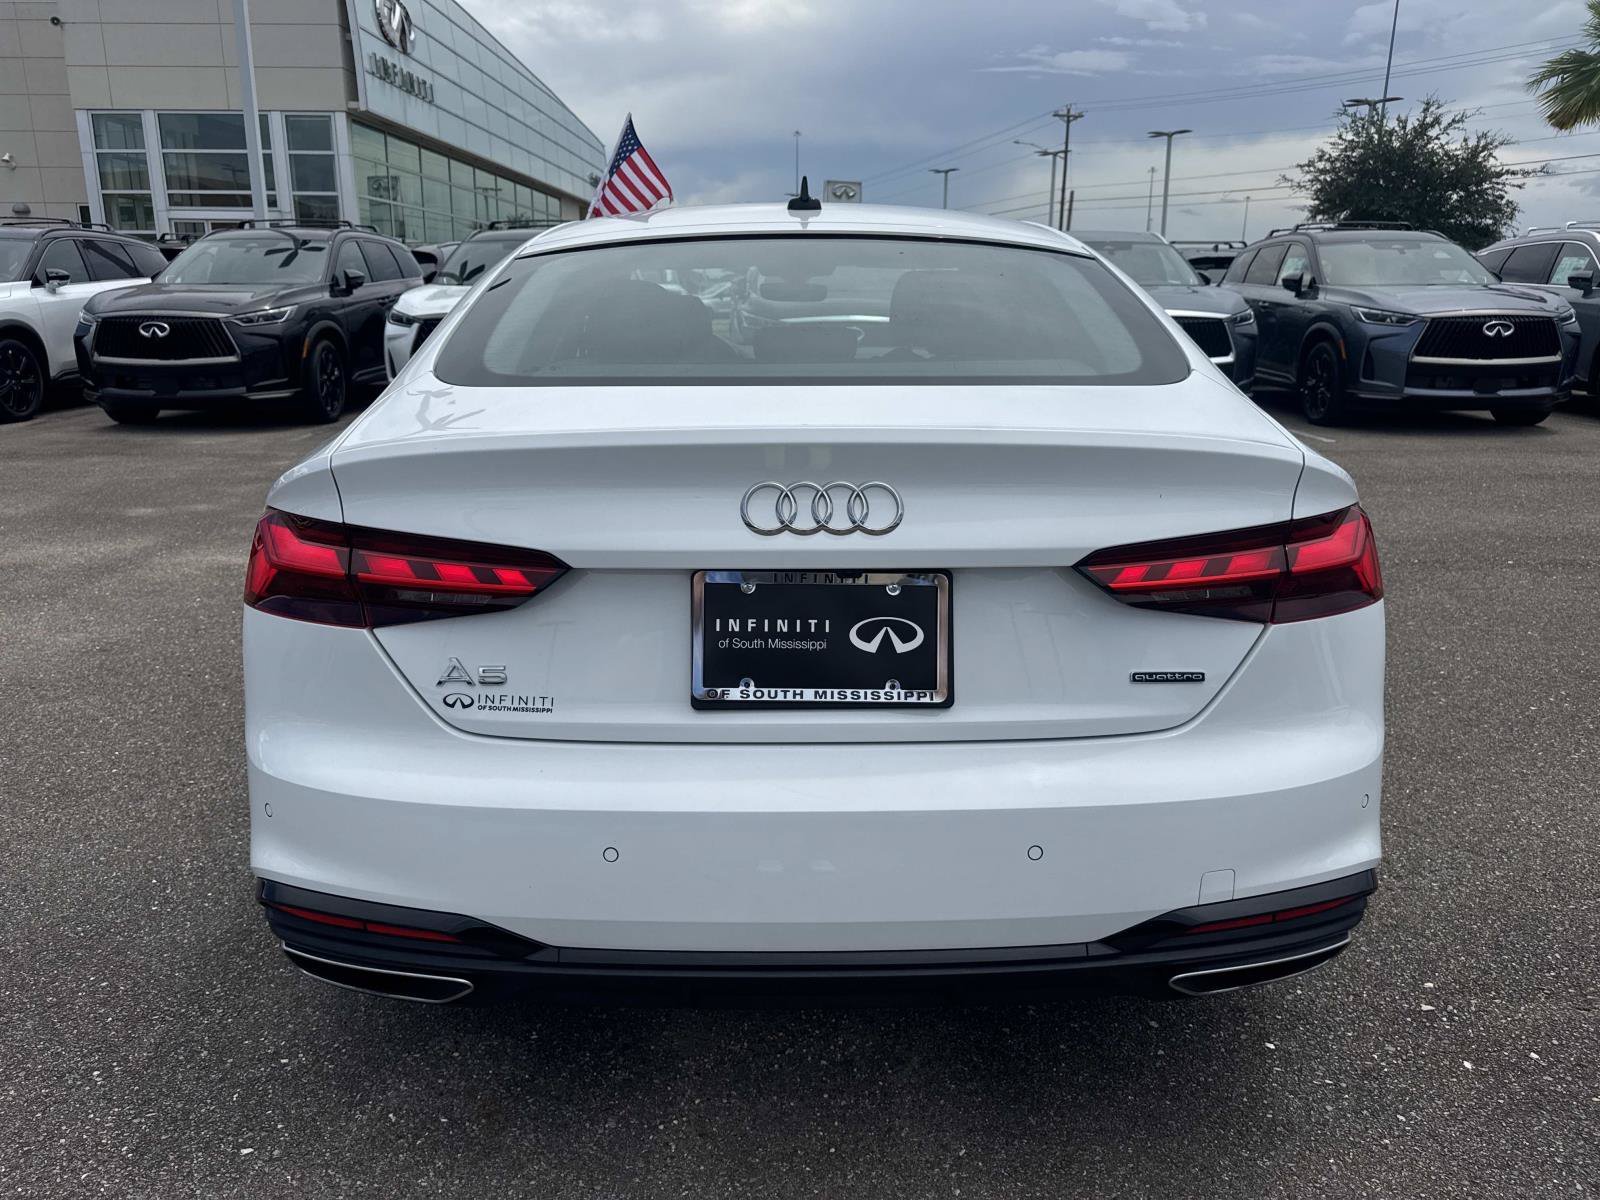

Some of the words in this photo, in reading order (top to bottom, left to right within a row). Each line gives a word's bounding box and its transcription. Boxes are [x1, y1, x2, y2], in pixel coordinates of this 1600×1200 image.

[715, 618, 830, 633] INFINITI
[718, 638, 730, 649] of
[732, 637, 765, 649] South
[768, 638, 827, 652] Mississippi
[435, 656, 508, 687] A5
[1134, 673, 1203, 681] quattro
[477, 693, 555, 708] INFINITI
[706, 688, 731, 700] OF
[739, 689, 804, 700] SOUTH
[813, 690, 935, 702] MISSISSIPPI
[512, 706, 553, 714] MISSISSIPPI
